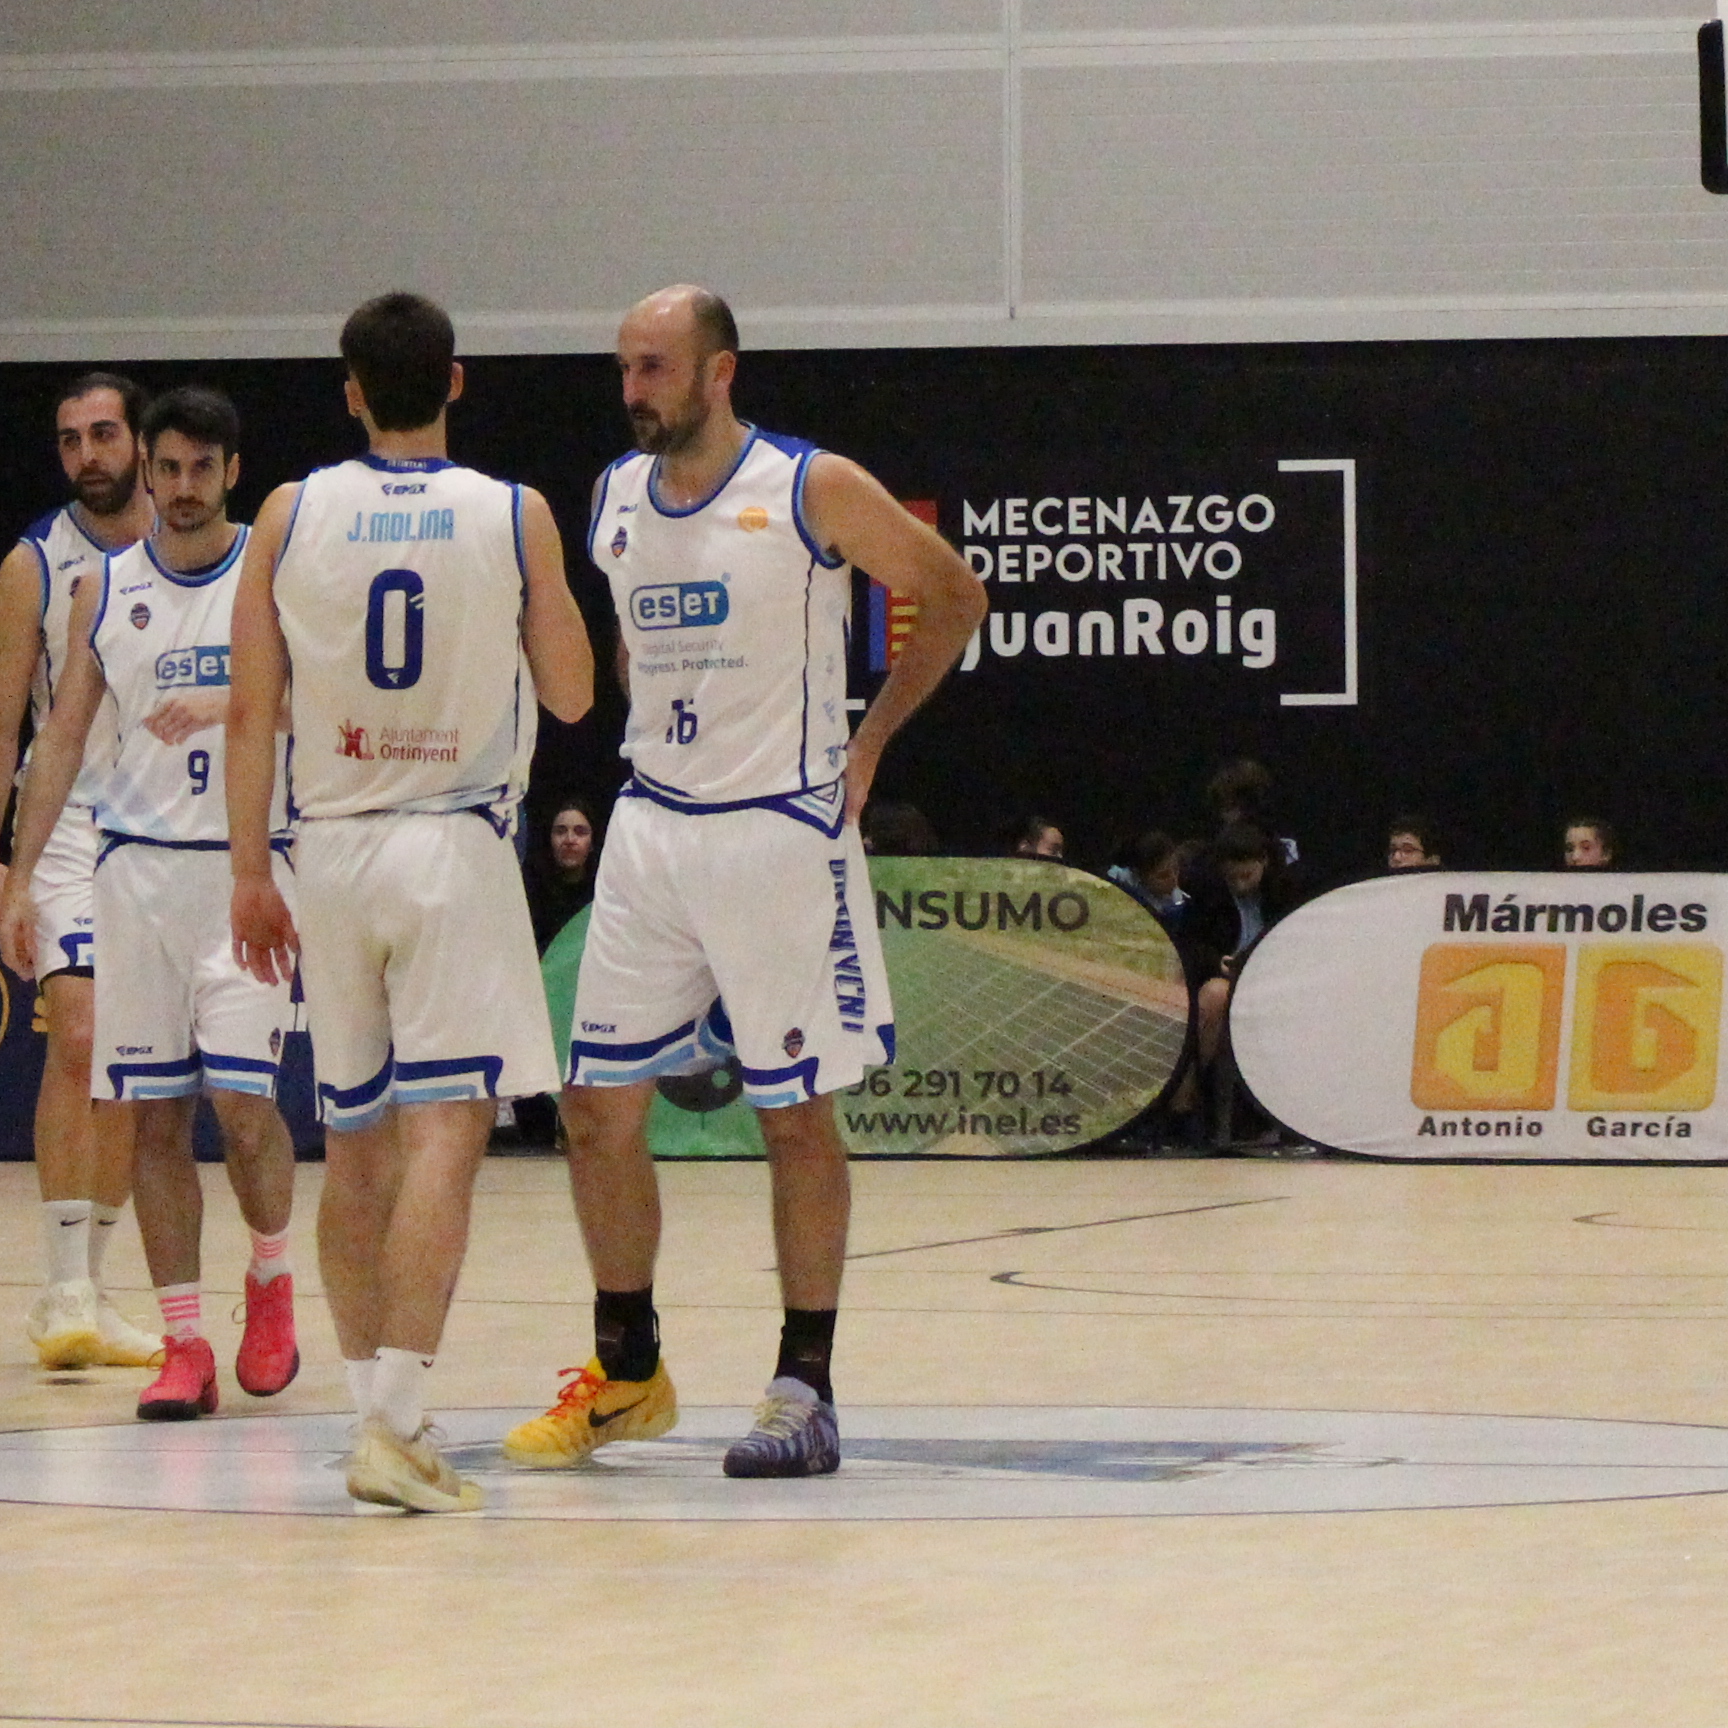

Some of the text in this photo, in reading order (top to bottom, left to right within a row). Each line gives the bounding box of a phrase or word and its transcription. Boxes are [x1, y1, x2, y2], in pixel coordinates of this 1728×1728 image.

[346, 508, 455, 543] J.MOLINA
[962, 493, 1276, 537] MECENAZGO
[963, 540, 1243, 584] DEPORTIVO
[365, 568, 424, 690] 0
[188, 749, 210, 796] 9
[379, 742, 459, 763] Ontinyent
[876, 889, 1091, 932] NSUMO
[1442, 892, 1709, 933] Mármoles
[902, 1069, 962, 1098] 291
[974, 1070, 1020, 1099] 70
[1032, 1070, 1072, 1099] 14
[843, 1104, 1082, 1135] www.inel.es
[1417, 1115, 1693, 1138] Antonio García
